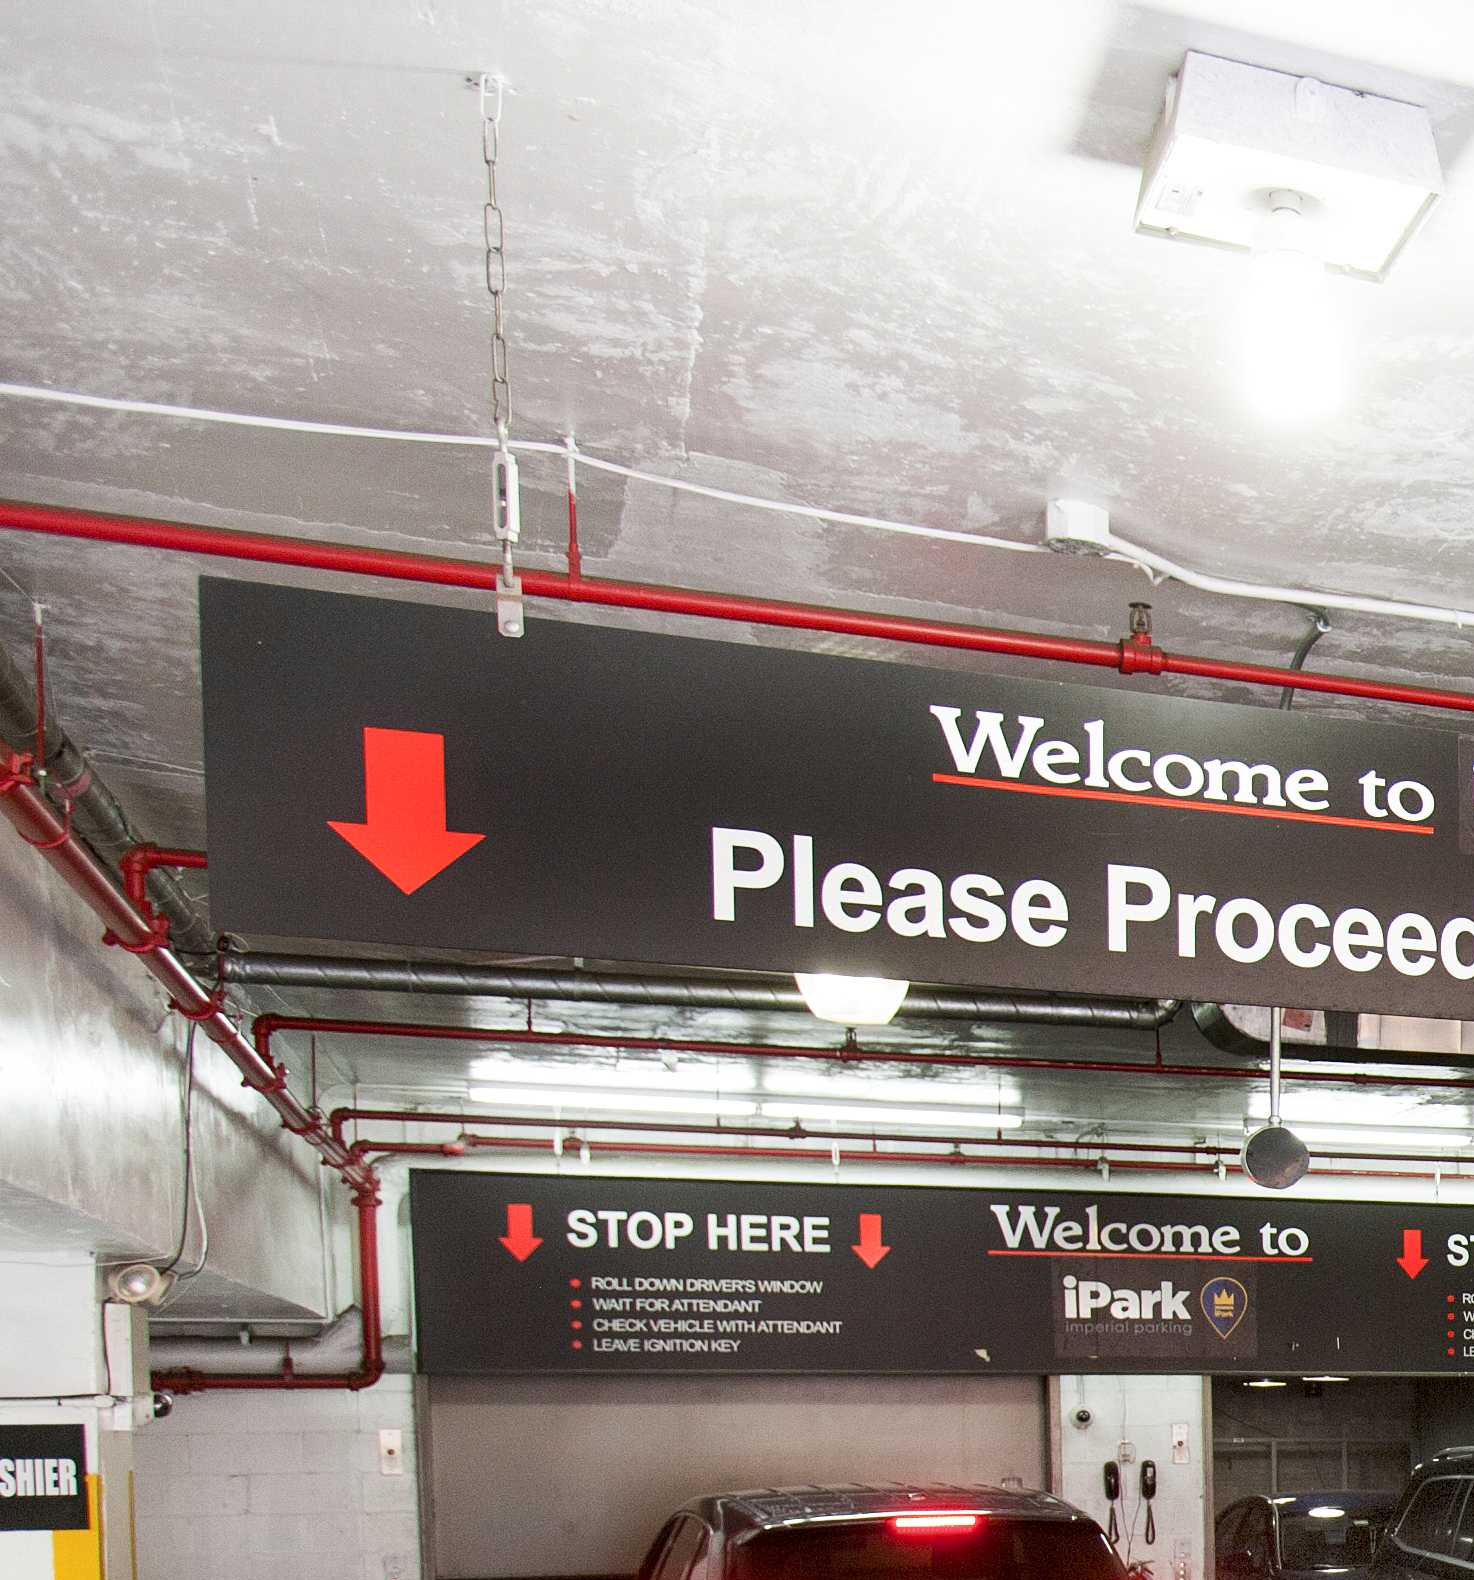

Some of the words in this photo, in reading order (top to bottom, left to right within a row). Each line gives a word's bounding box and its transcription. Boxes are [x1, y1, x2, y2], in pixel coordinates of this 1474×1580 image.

[930, 705, 1329, 812] Welcome
[1359, 771, 1435, 822] to
[712, 827, 1069, 948] Please
[567, 1210, 694, 1249] STOP
[707, 1214, 831, 1252] HERE
[989, 1204, 1241, 1252] Welcome
[1261, 1222, 1310, 1256] to
[592, 1277, 632, 1290] ROLL
[635, 1278, 683, 1291] DOWN
[687, 1278, 755, 1293] DRIVER'S
[758, 1280, 822, 1293] WINDOW
[593, 1298, 631, 1311] WAIT
[636, 1299, 670, 1311] FOR
[671, 1300, 762, 1312] ATTENDANT
[1064, 1276, 1192, 1319] iPark
[593, 1319, 647, 1332] CHECK
[650, 1319, 714, 1332] VEHICLE
[717, 1320, 756, 1333] WITH
[757, 1321, 842, 1334] ATTENDANT
[593, 1339, 640, 1351] LEAVE
[644, 1339, 708, 1352] IGNITION
[711, 1340, 740, 1352] KEY
